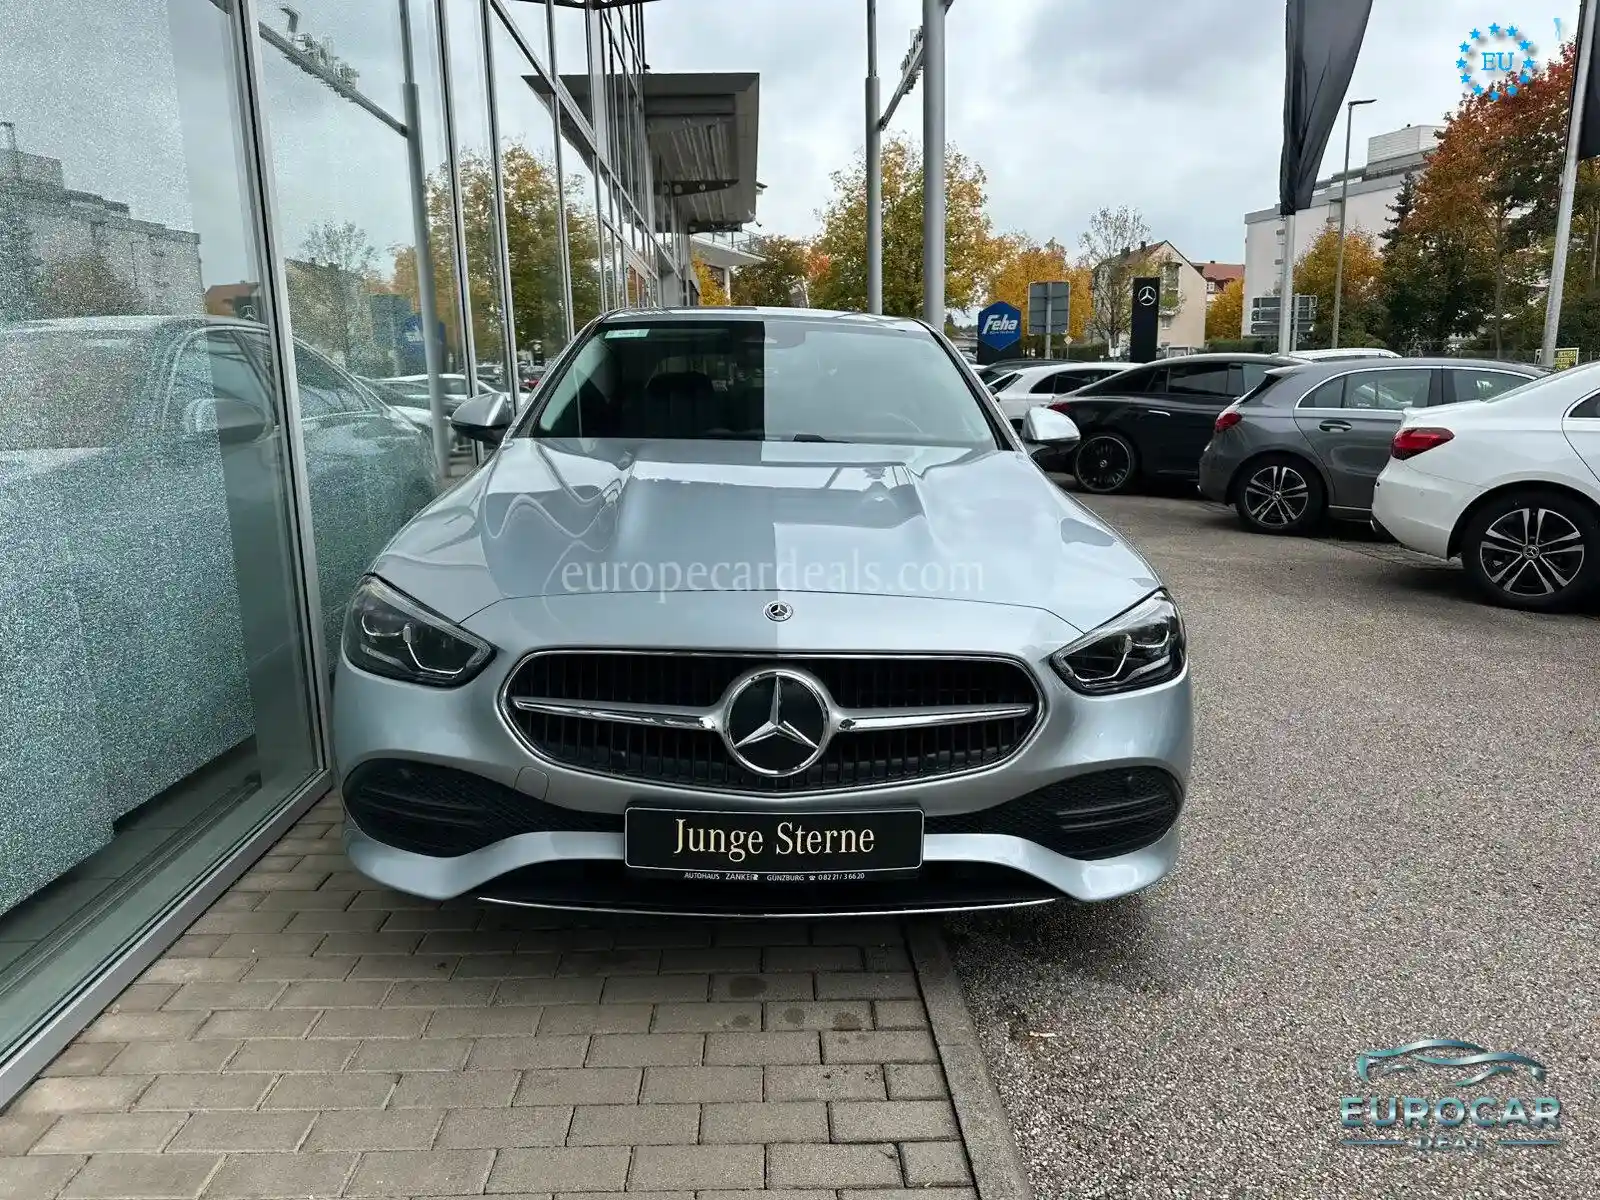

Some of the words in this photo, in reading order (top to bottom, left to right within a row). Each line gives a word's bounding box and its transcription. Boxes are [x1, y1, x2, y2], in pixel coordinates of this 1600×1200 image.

[981, 313, 1019, 335] Feha
[673, 817, 764, 863] Junge
[775, 820, 876, 856] Sterne
[683, 871, 721, 881] AUTOHAUS
[766, 873, 805, 882] GÜNZBURG
